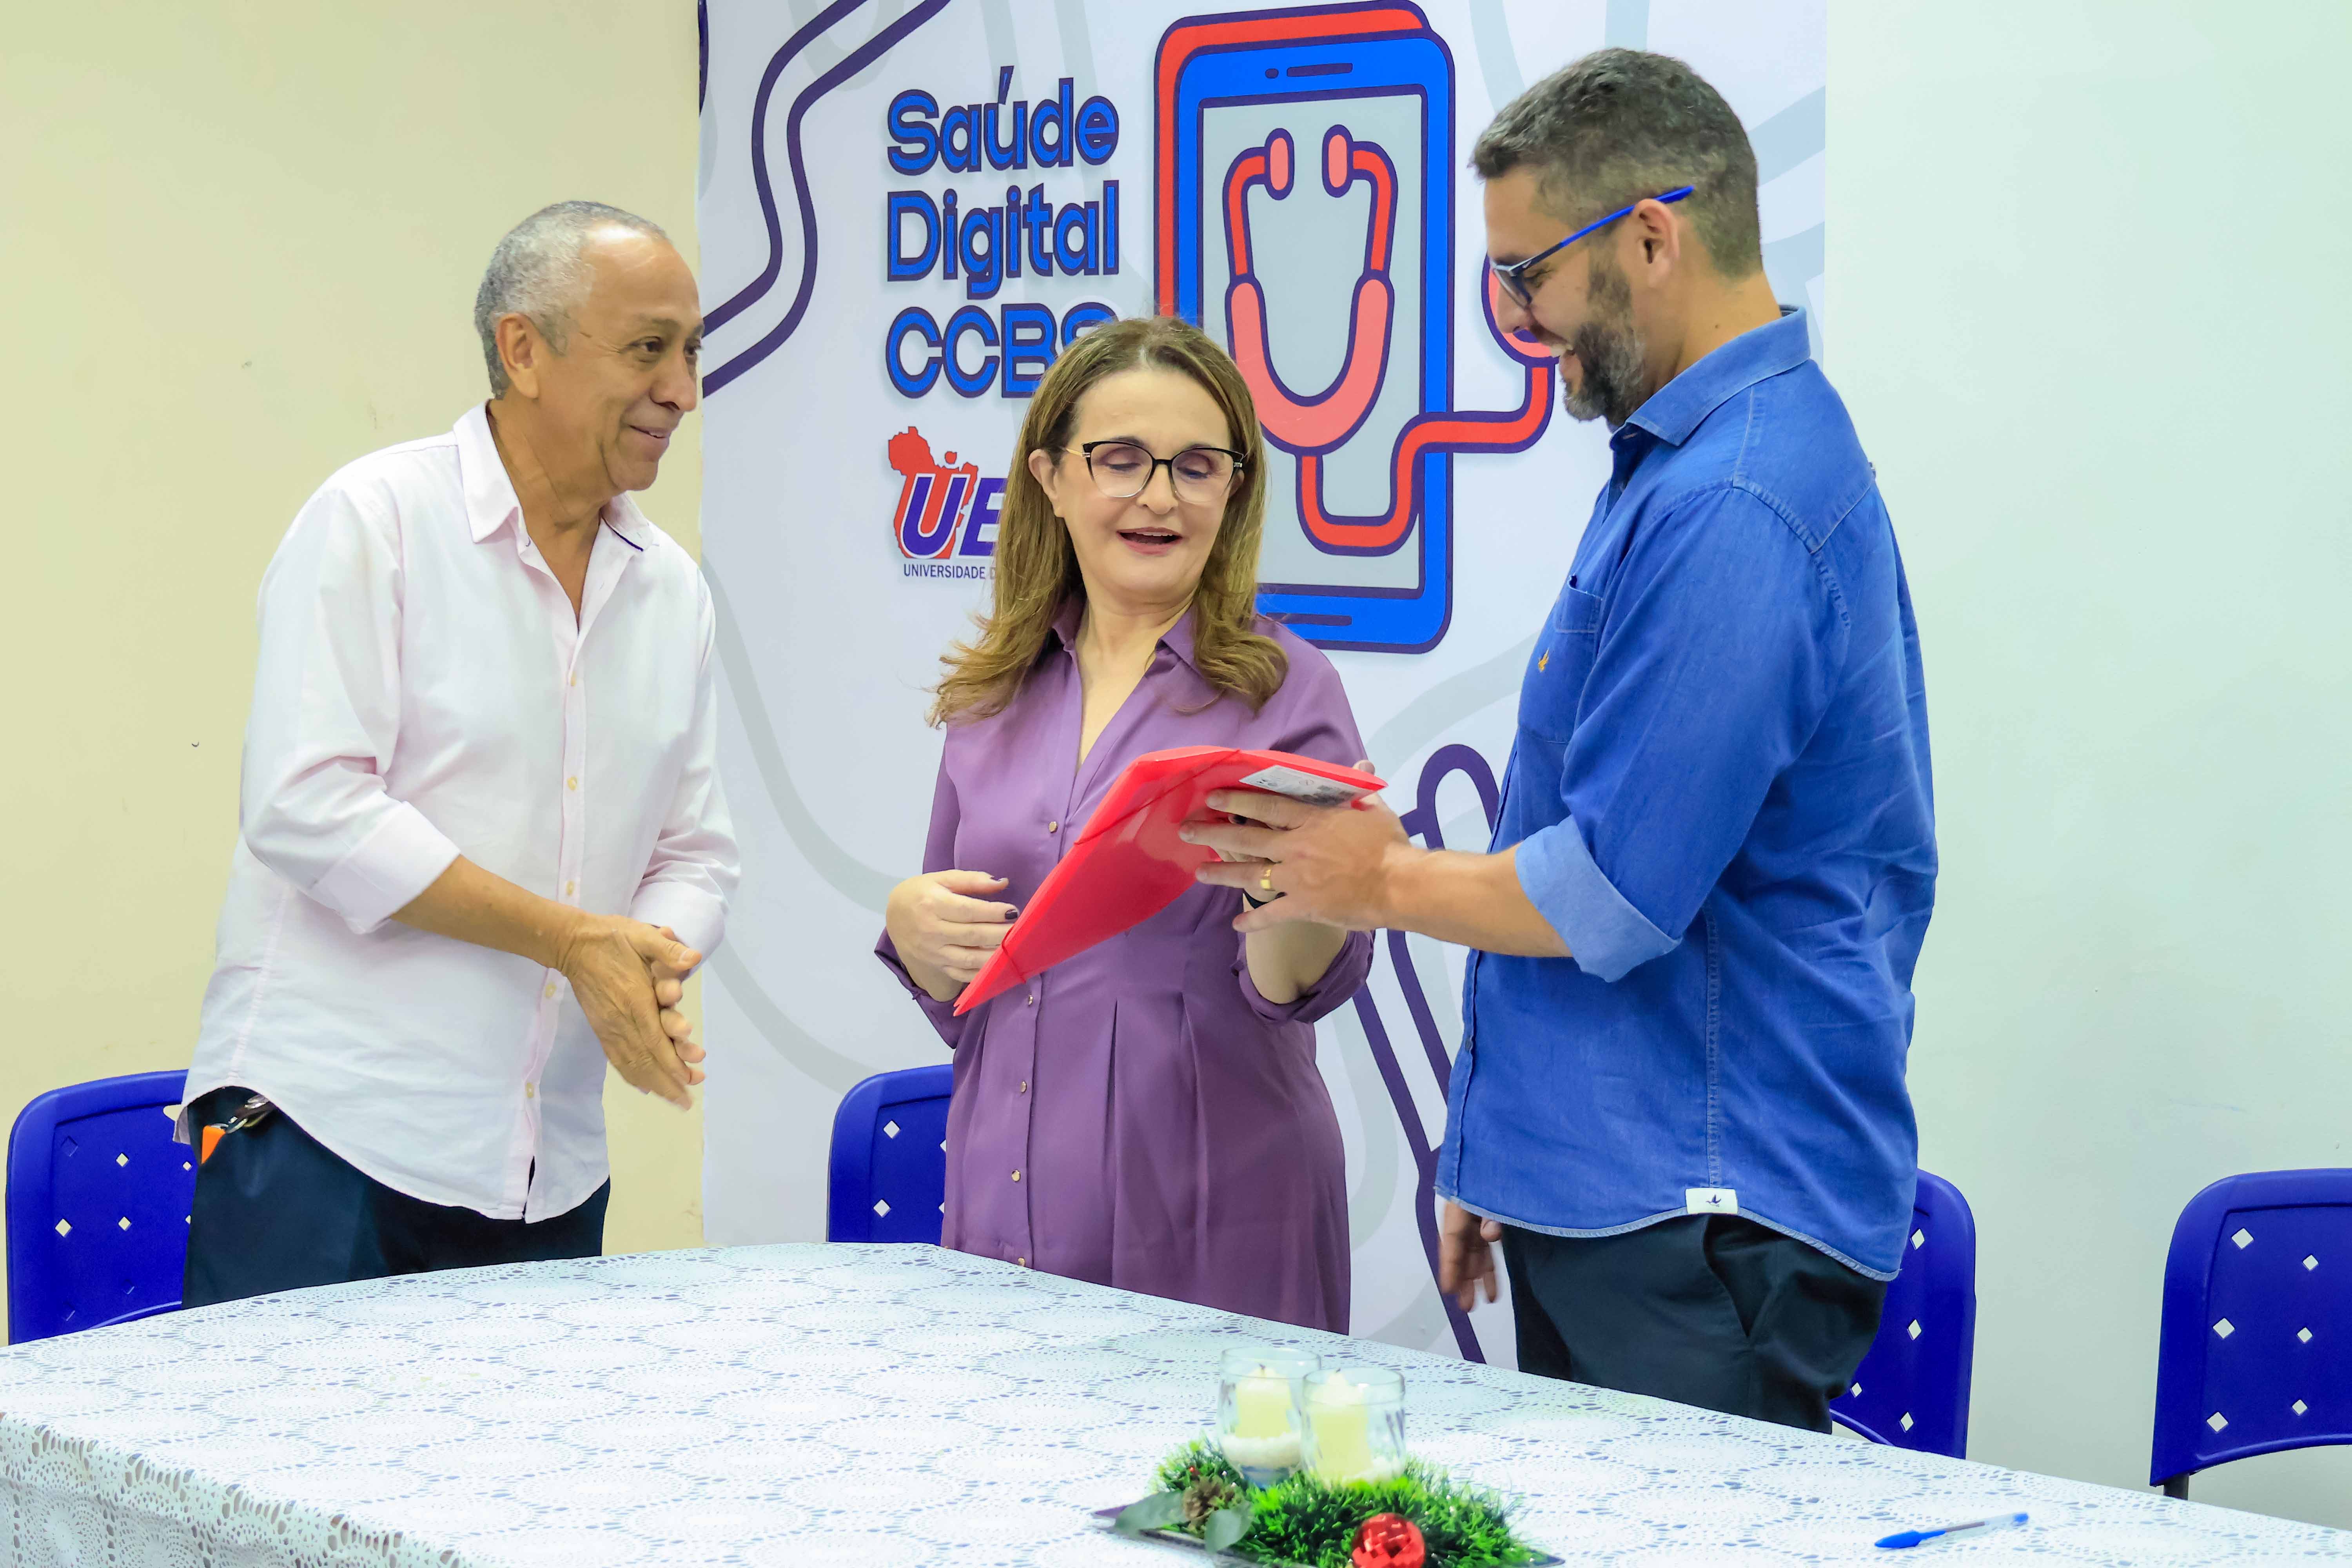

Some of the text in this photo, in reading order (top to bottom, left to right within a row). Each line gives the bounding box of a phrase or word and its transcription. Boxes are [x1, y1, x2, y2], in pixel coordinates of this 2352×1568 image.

[887, 65, 1119, 175] Saúde
[887, 180, 1119, 299] Digital
[904, 563, 985, 579] UNIVERSIDADE
